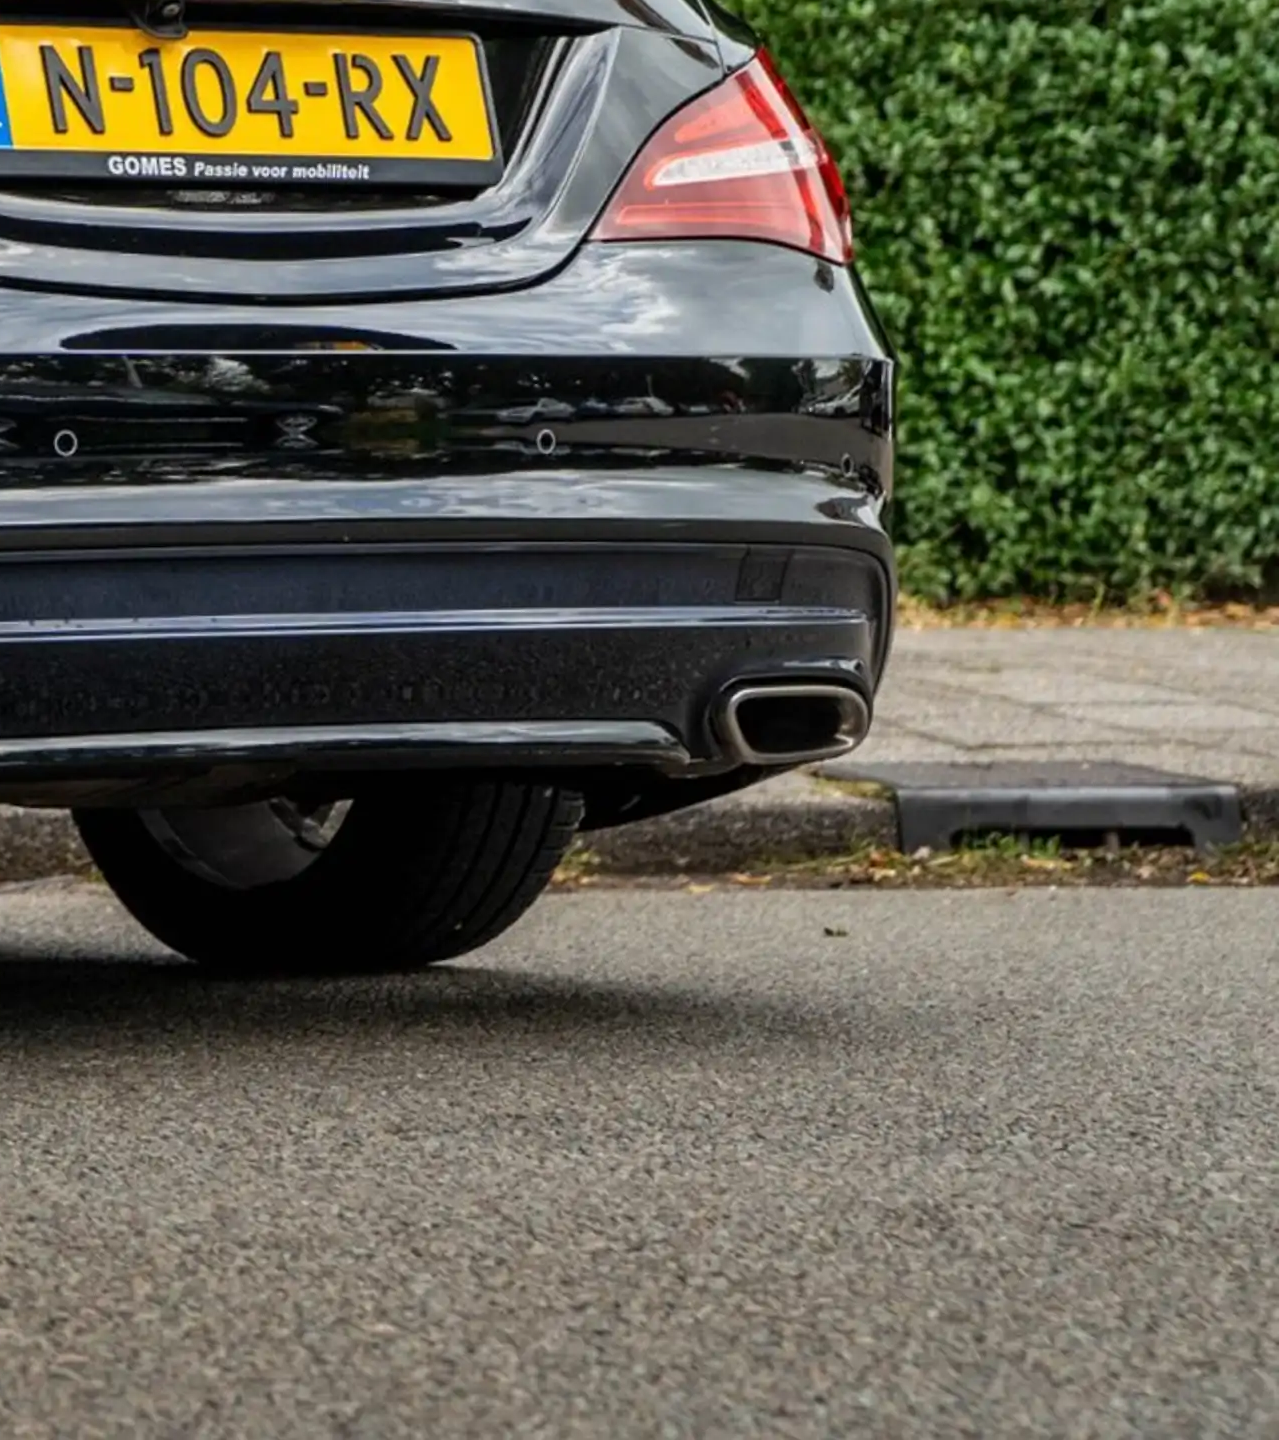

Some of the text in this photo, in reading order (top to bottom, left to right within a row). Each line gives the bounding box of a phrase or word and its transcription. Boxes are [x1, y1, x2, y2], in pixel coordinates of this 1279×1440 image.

[38, 45, 452, 142] N-104-RX
[107, 155, 371, 180] GOMES Passie voor mobiliteit
